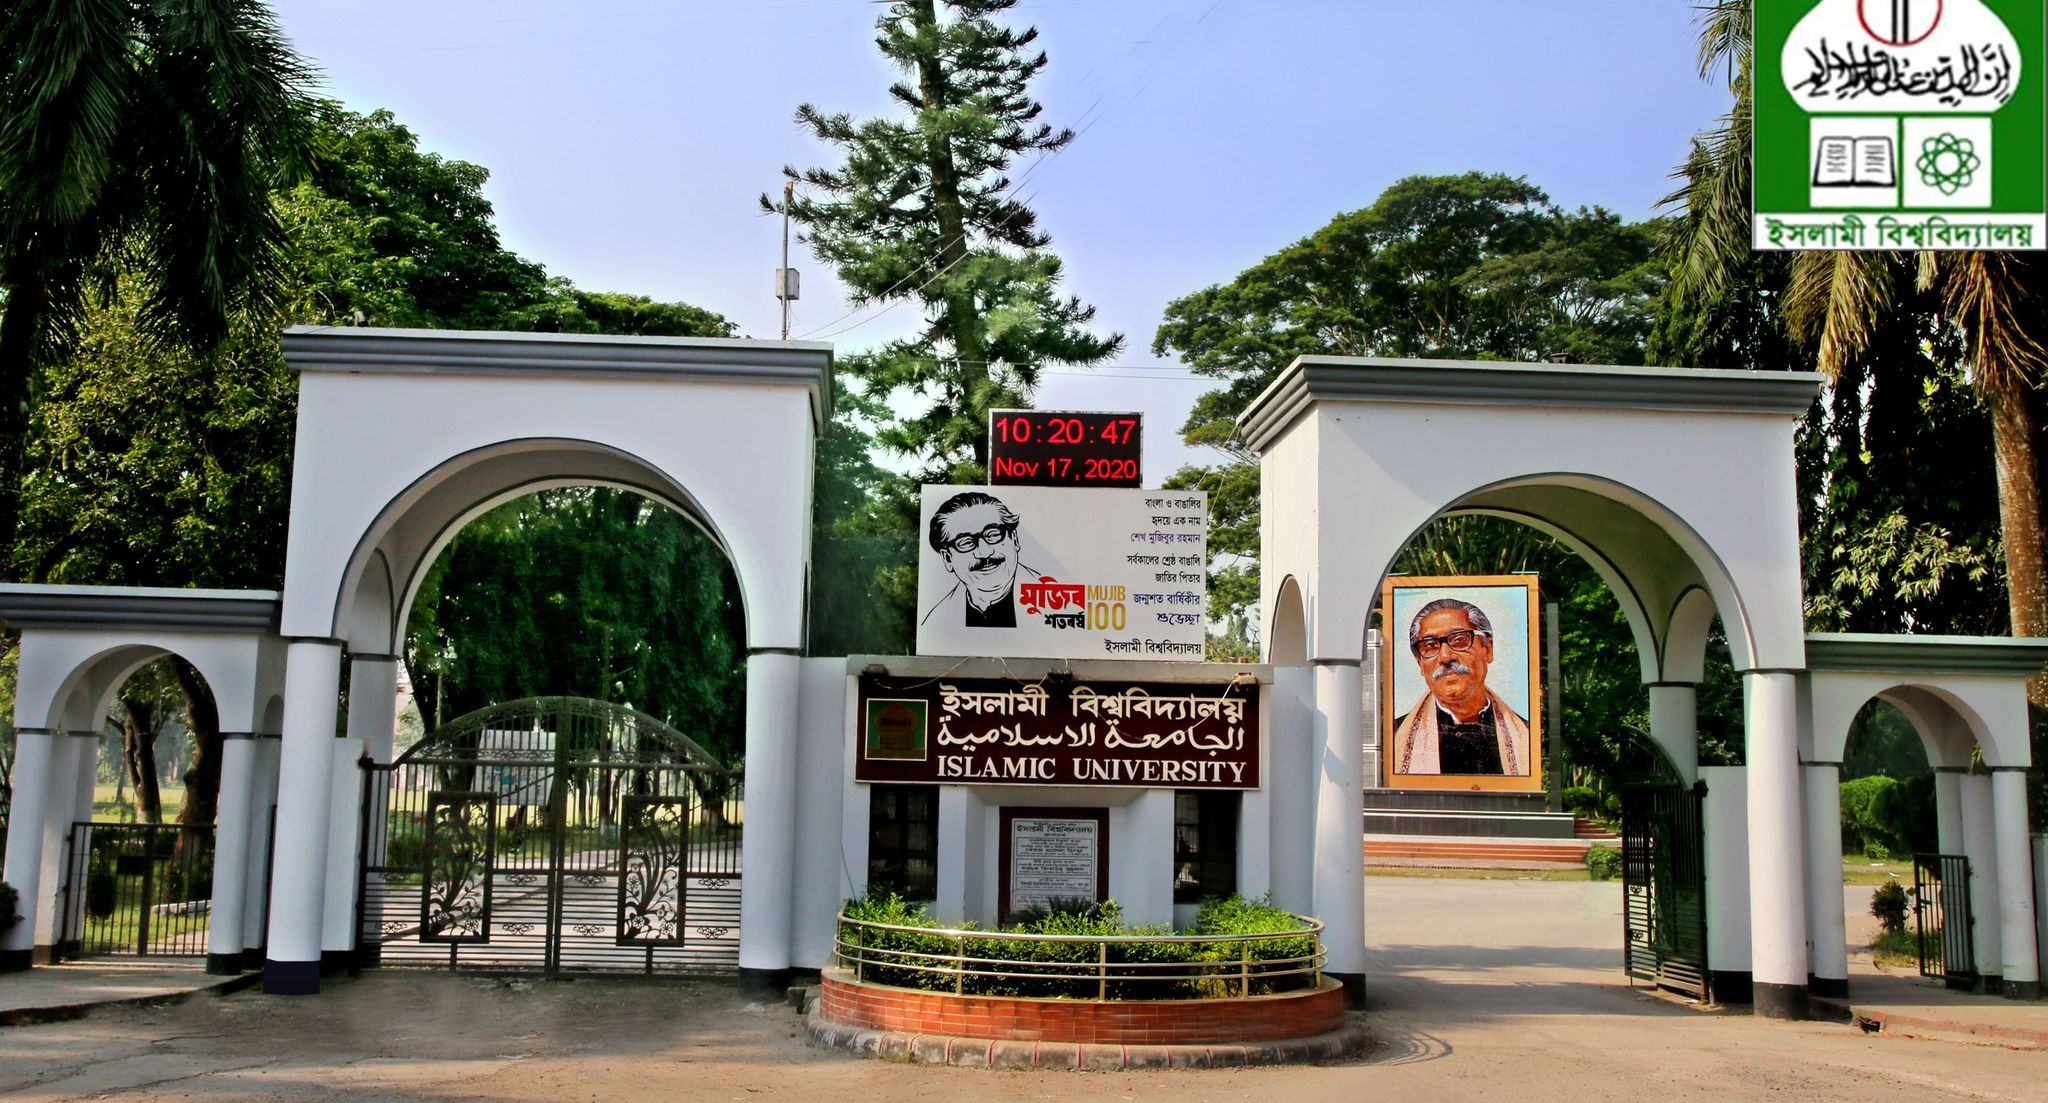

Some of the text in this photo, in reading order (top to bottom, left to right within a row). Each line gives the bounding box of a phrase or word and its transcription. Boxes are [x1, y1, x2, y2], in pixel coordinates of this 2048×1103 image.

[996, 417, 1136, 445] 10:20:47
[996, 456, 1040, 477] Nov
[1145, 497, 1201, 509] বাংলা ও বাঙালির
[1151, 516, 1201, 526] হৃদয়ে এক নাম
[1131, 530, 1201, 544] শেখ মুজিবুর রহমান
[1127, 553, 1201, 566] সর্বকালের শ্রেষ্ঠ বাঙালি
[1155, 570, 1200, 583] জাতির পিতার
[1020, 576, 1086, 615] মুজিব
[1087, 585, 1127, 601] MUJIB
[1133, 591, 1200, 605] জন্মশত বার্ষিকীর
[1044, 611, 1086, 630] শতবর্ষ
[1087, 602, 1127, 631] 100
[1156, 612, 1200, 625] শুভেচ্ছা
[1104, 638, 1202, 655] ইসলামী বিশ্ববিদ্যালয়
[939, 682, 1247, 724] ইসলামী বিশ্ববিদ্যালয়
[937, 715, 1245, 757] الجامعة الاسلامية
[937, 755, 1247, 783] ISLAMIC UNIVERSITY
